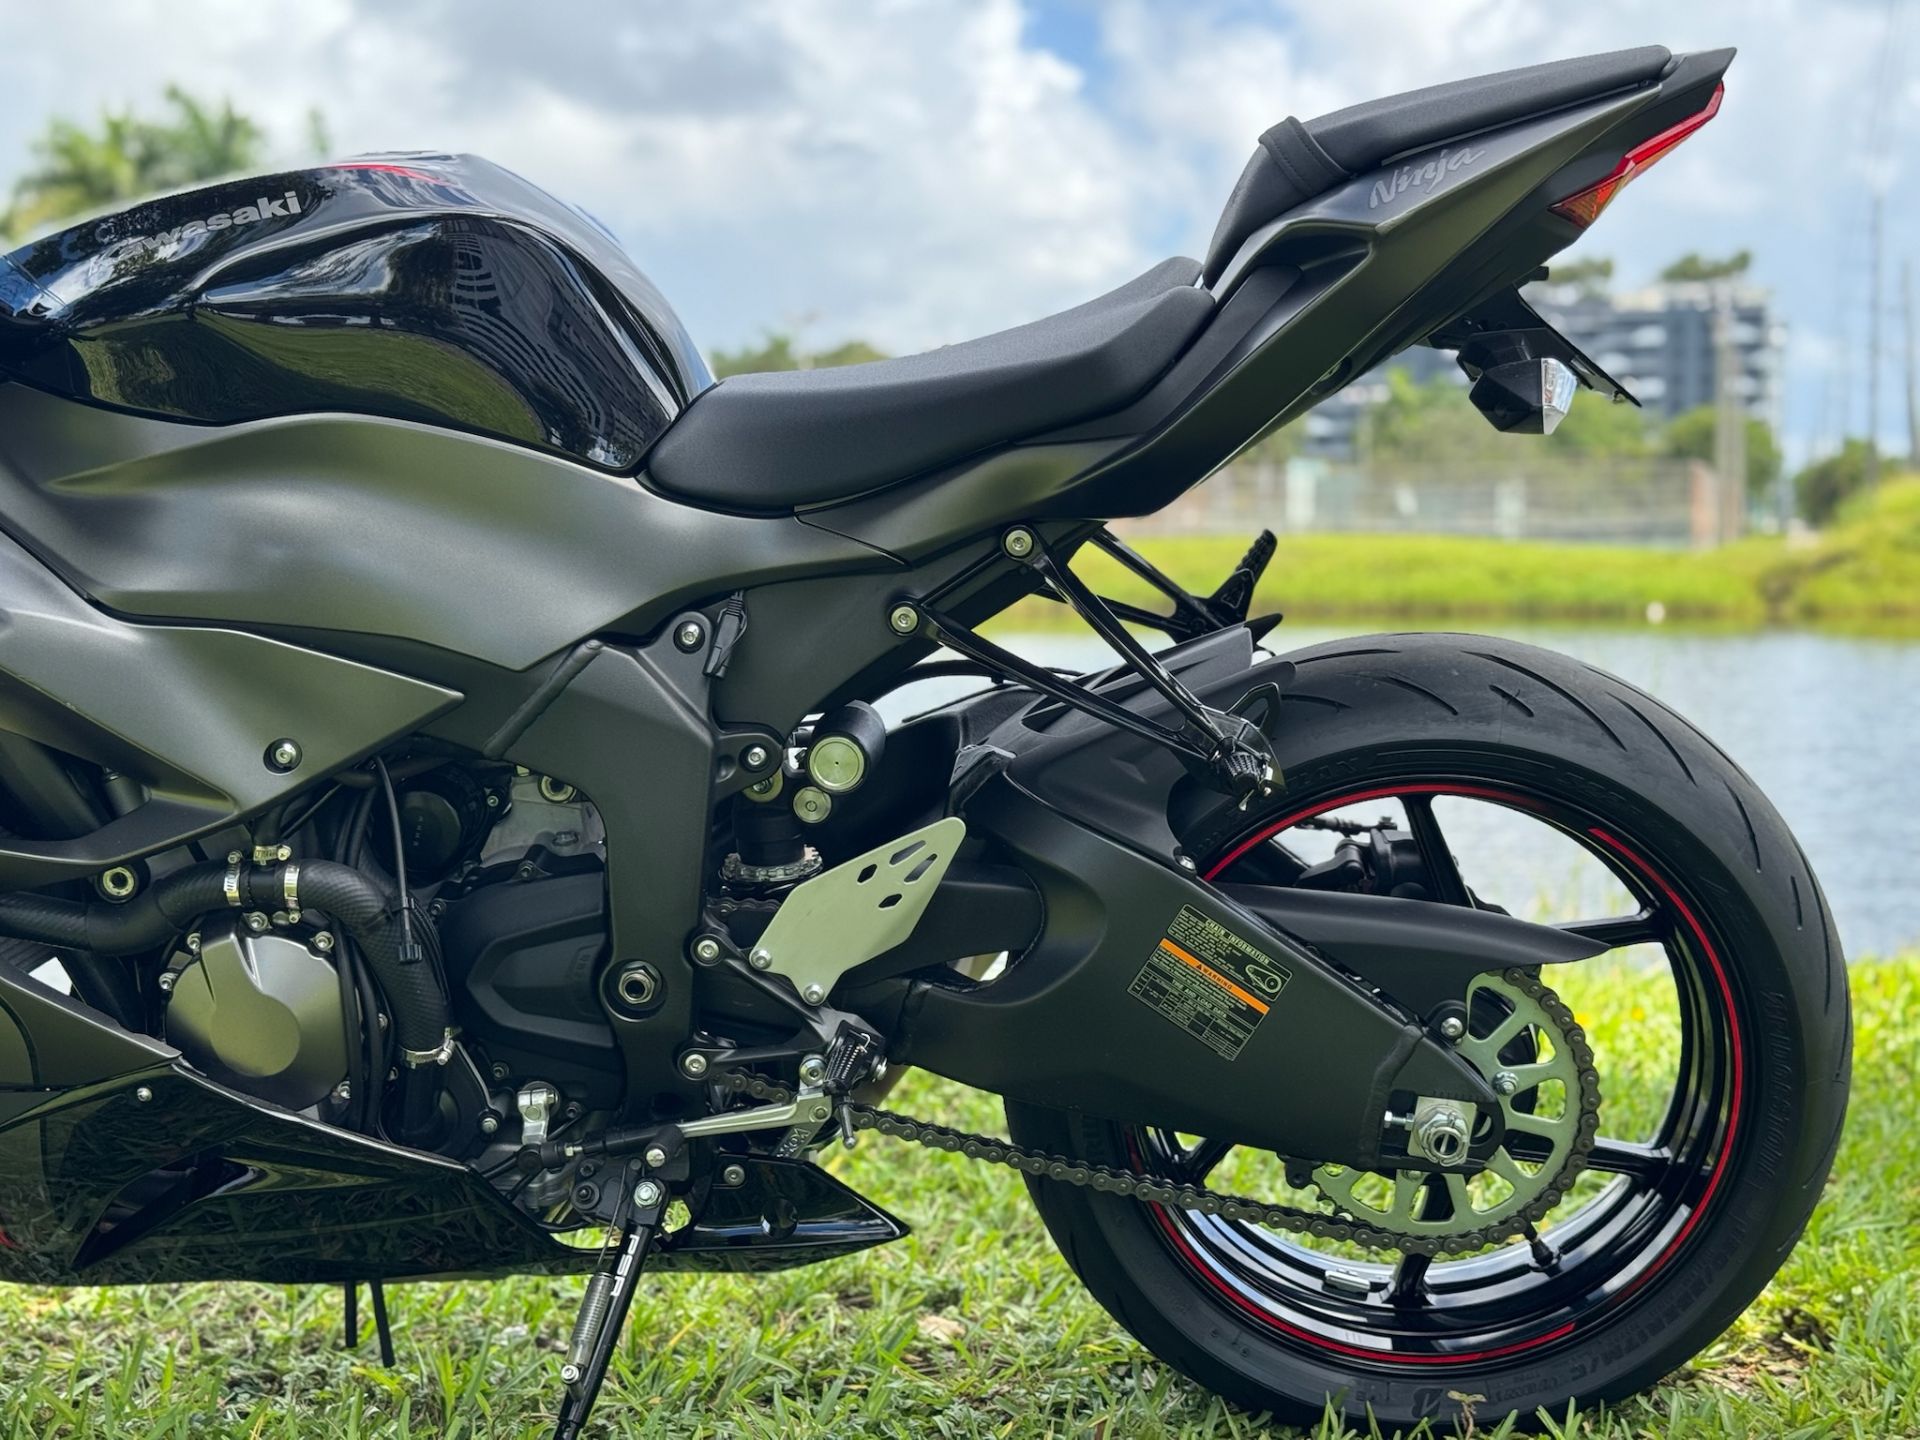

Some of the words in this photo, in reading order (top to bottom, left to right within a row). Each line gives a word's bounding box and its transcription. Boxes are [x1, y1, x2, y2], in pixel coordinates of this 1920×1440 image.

[1369, 147, 1485, 209] Ninja
[1204, 919, 1226, 938] CHAIN
[1228, 932, 1271, 965] INFORMATION
[1202, 967, 1233, 991] WARNING
[1184, 987, 1198, 1000] AND
[1197, 994, 1214, 1009] LOAD
[1213, 1005, 1228, 1019] DATA
[610, 1234, 640, 1297] PSR
